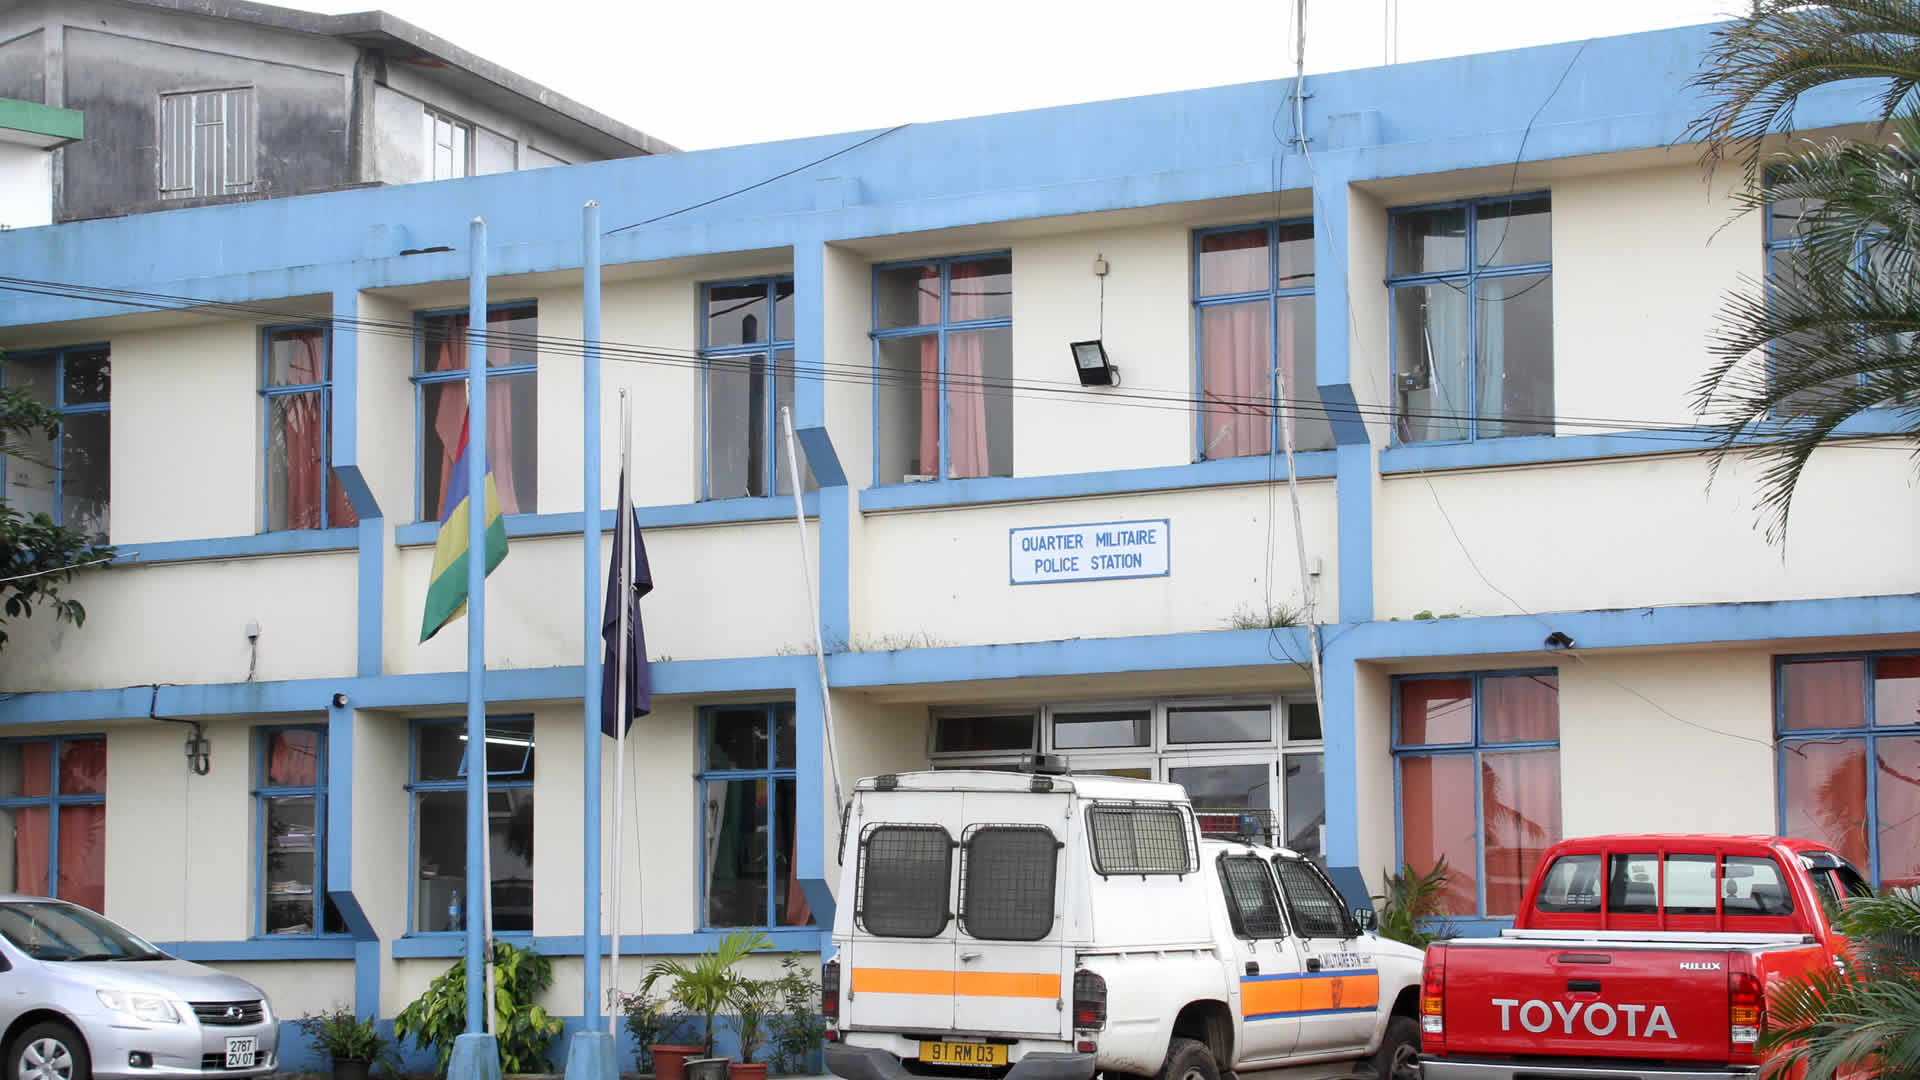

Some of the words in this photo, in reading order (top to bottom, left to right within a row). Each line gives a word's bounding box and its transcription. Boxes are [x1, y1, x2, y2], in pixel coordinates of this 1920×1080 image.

[1022, 534, 1083, 552] QUARTIER
[1096, 529, 1157, 547] MILITAIRE
[1035, 557, 1079, 573] POLICE
[1091, 553, 1142, 570] STATION
[1679, 962, 1721, 970] HILUX
[1491, 998, 1678, 1039] TOYOTA
[230, 1040, 252, 1052] 2787
[932, 1043, 948, 1060] 91
[954, 1045, 972, 1061] RM
[977, 1046, 994, 1062] 03
